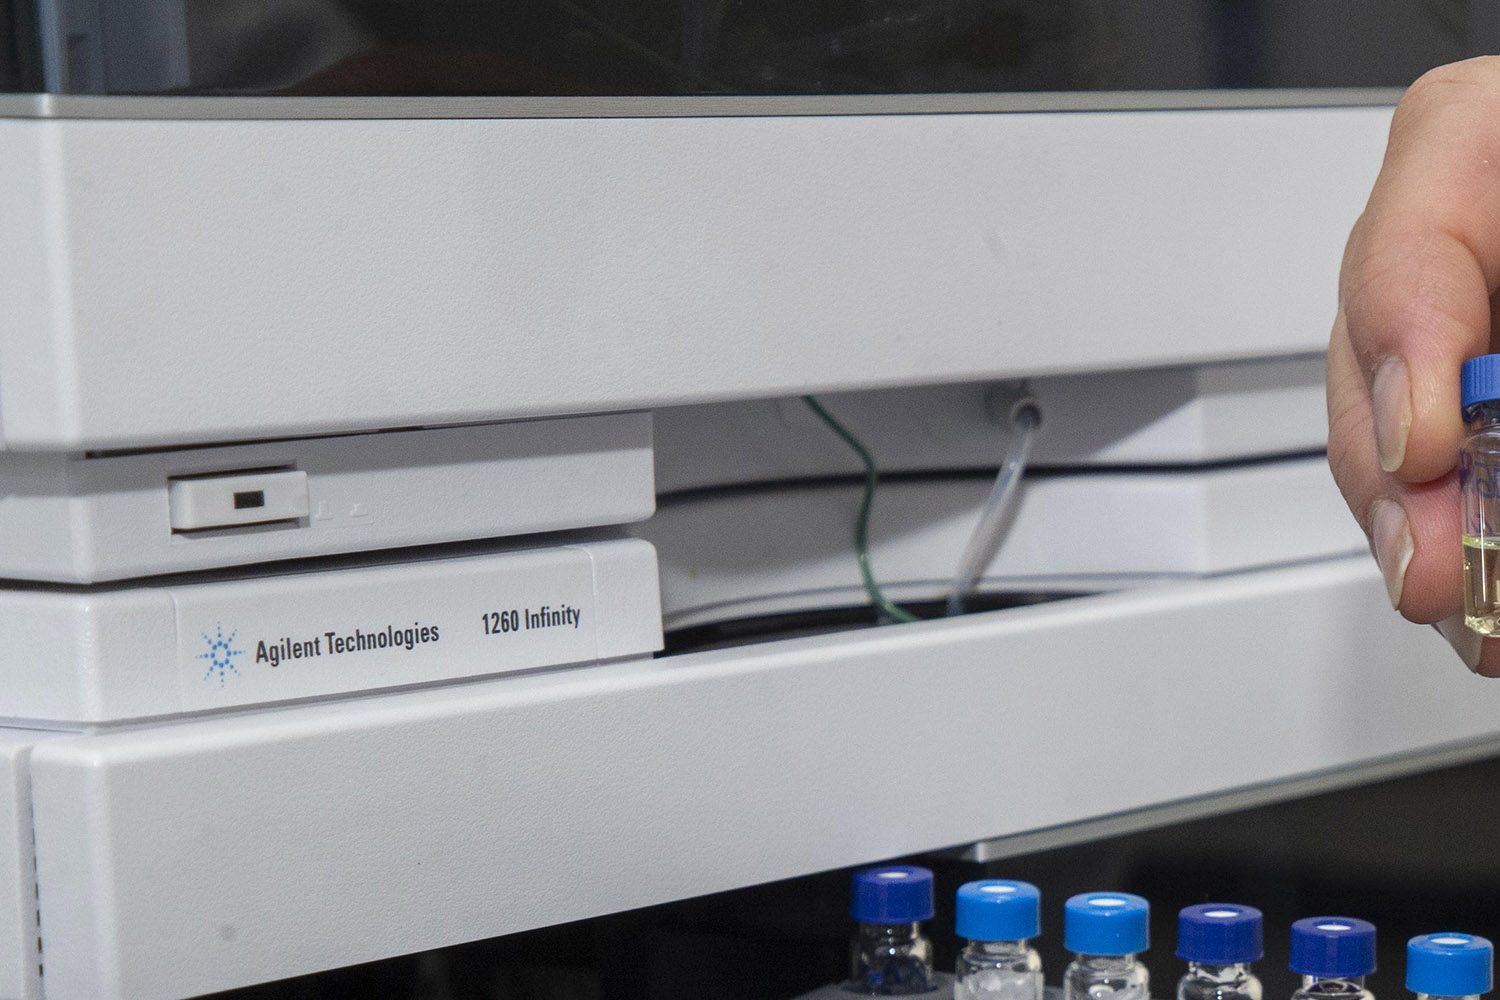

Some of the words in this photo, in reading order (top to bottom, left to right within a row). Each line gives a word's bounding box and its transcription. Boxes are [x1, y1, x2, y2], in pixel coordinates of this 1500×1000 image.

[256, 637, 321, 667] Agilent
[324, 621, 440, 655] Technologies
[482, 609, 519, 635] 1260
[525, 604, 581, 630] Infinity
